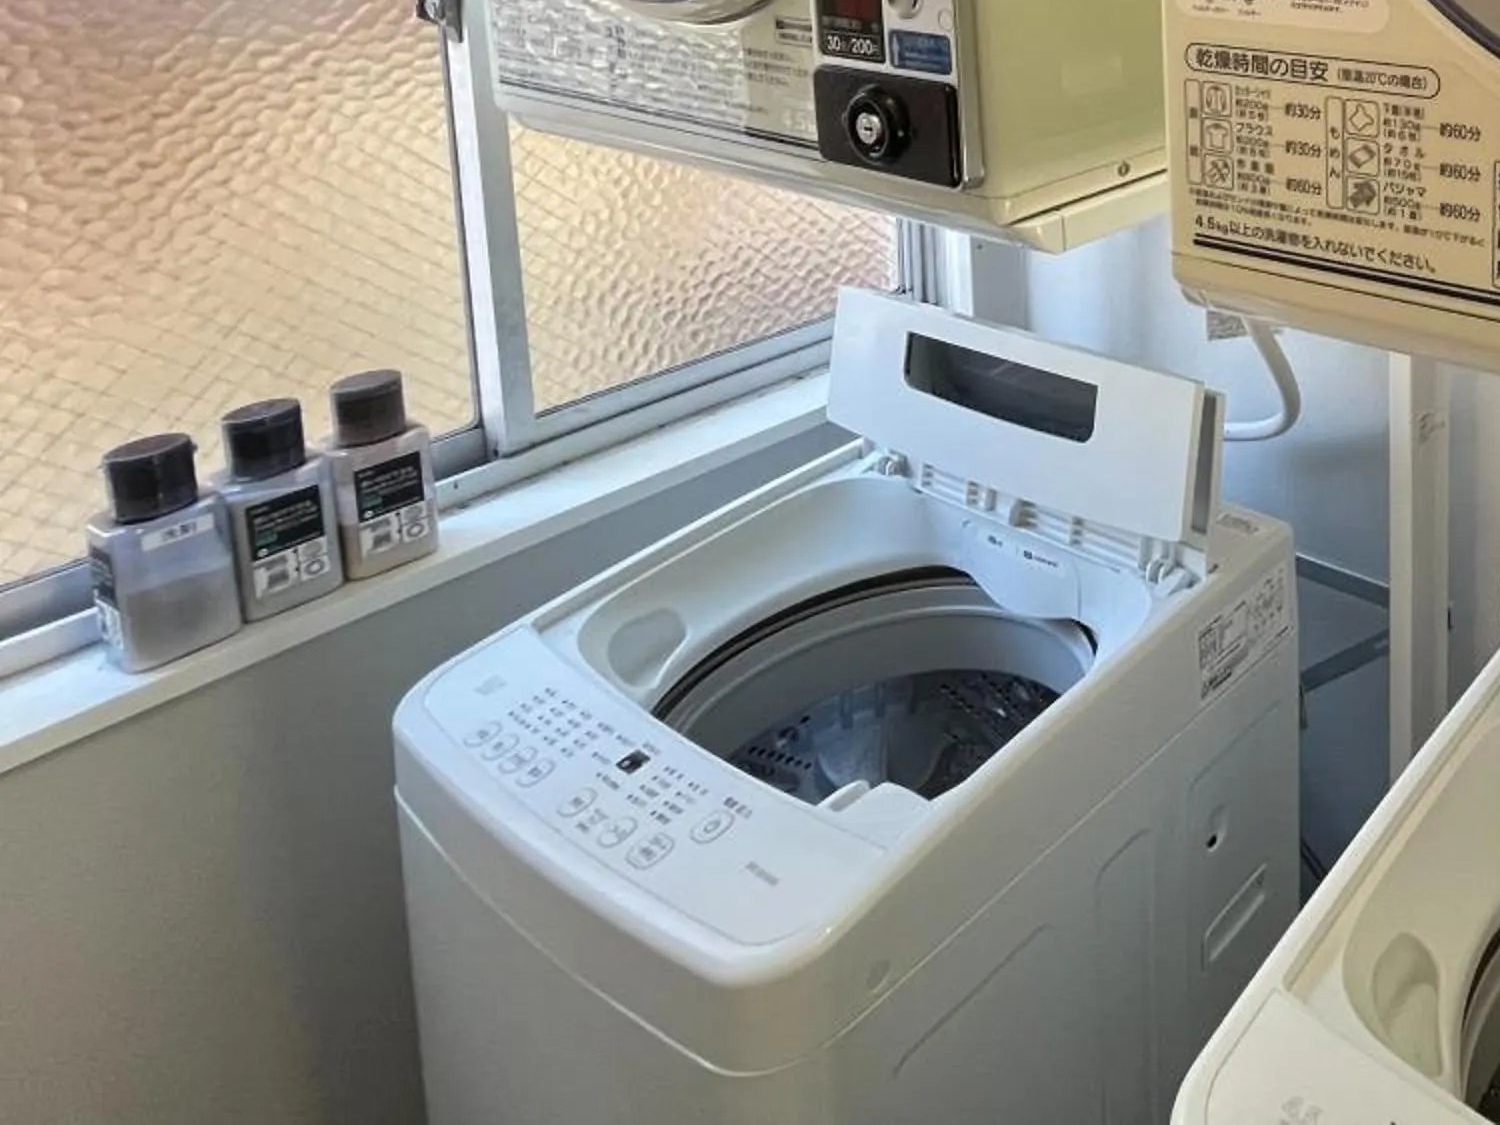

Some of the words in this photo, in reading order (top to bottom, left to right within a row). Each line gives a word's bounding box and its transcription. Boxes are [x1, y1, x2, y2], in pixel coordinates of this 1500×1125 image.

[1196, 48, 1329, 82] 乾燥時間の目安
